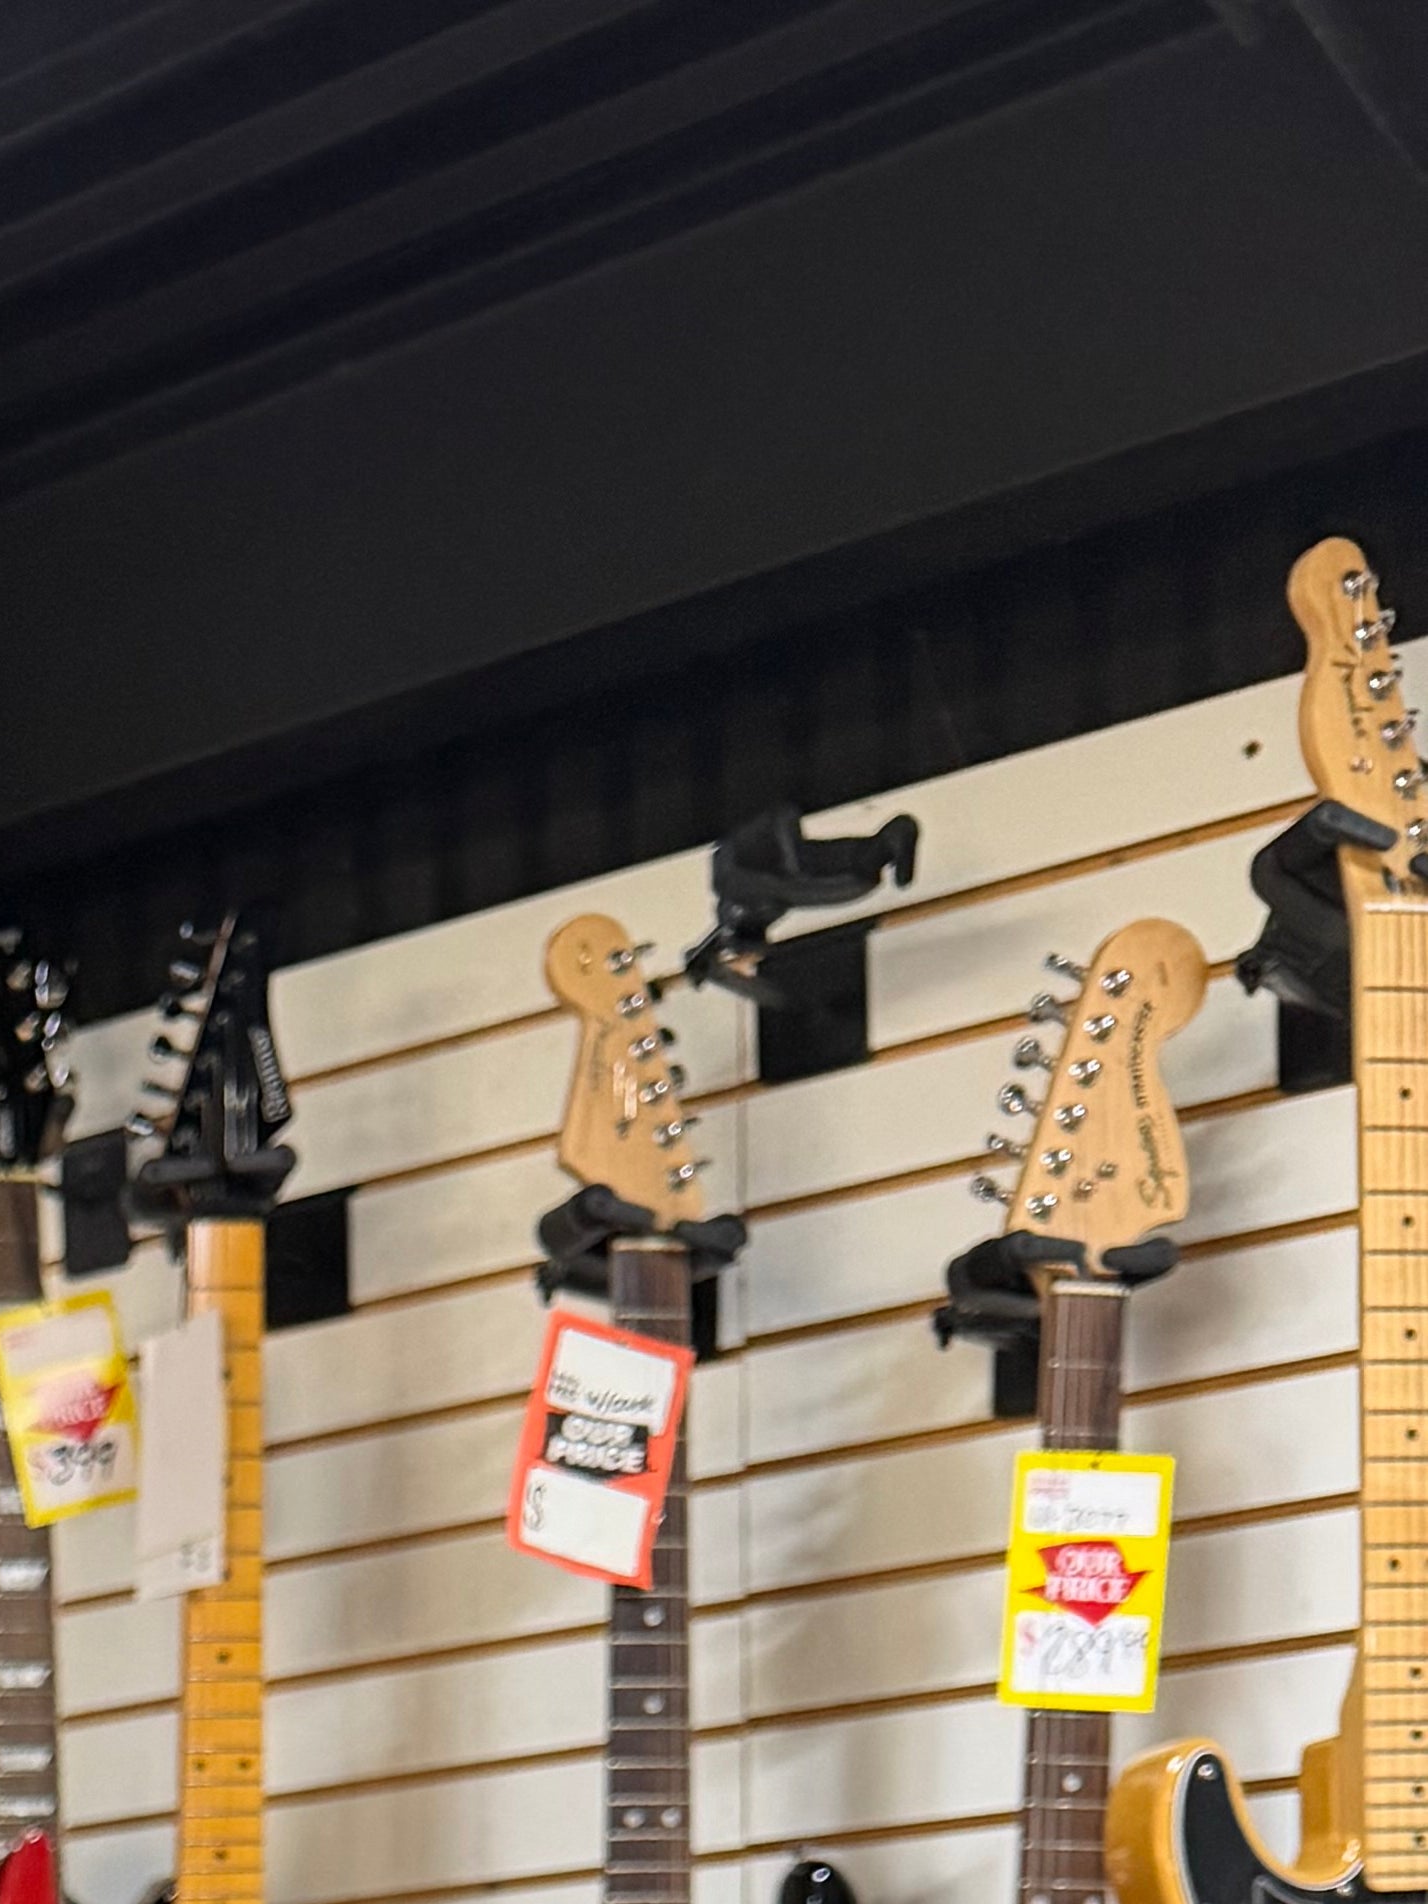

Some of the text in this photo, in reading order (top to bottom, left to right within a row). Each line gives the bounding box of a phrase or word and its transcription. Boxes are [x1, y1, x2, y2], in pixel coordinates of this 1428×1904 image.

[560, 1412, 637, 1450] OUR
[545, 1434, 647, 1475] PRICE
[1054, 1543, 1125, 1578] OUR
[1044, 1573, 1131, 1604] PRICE
